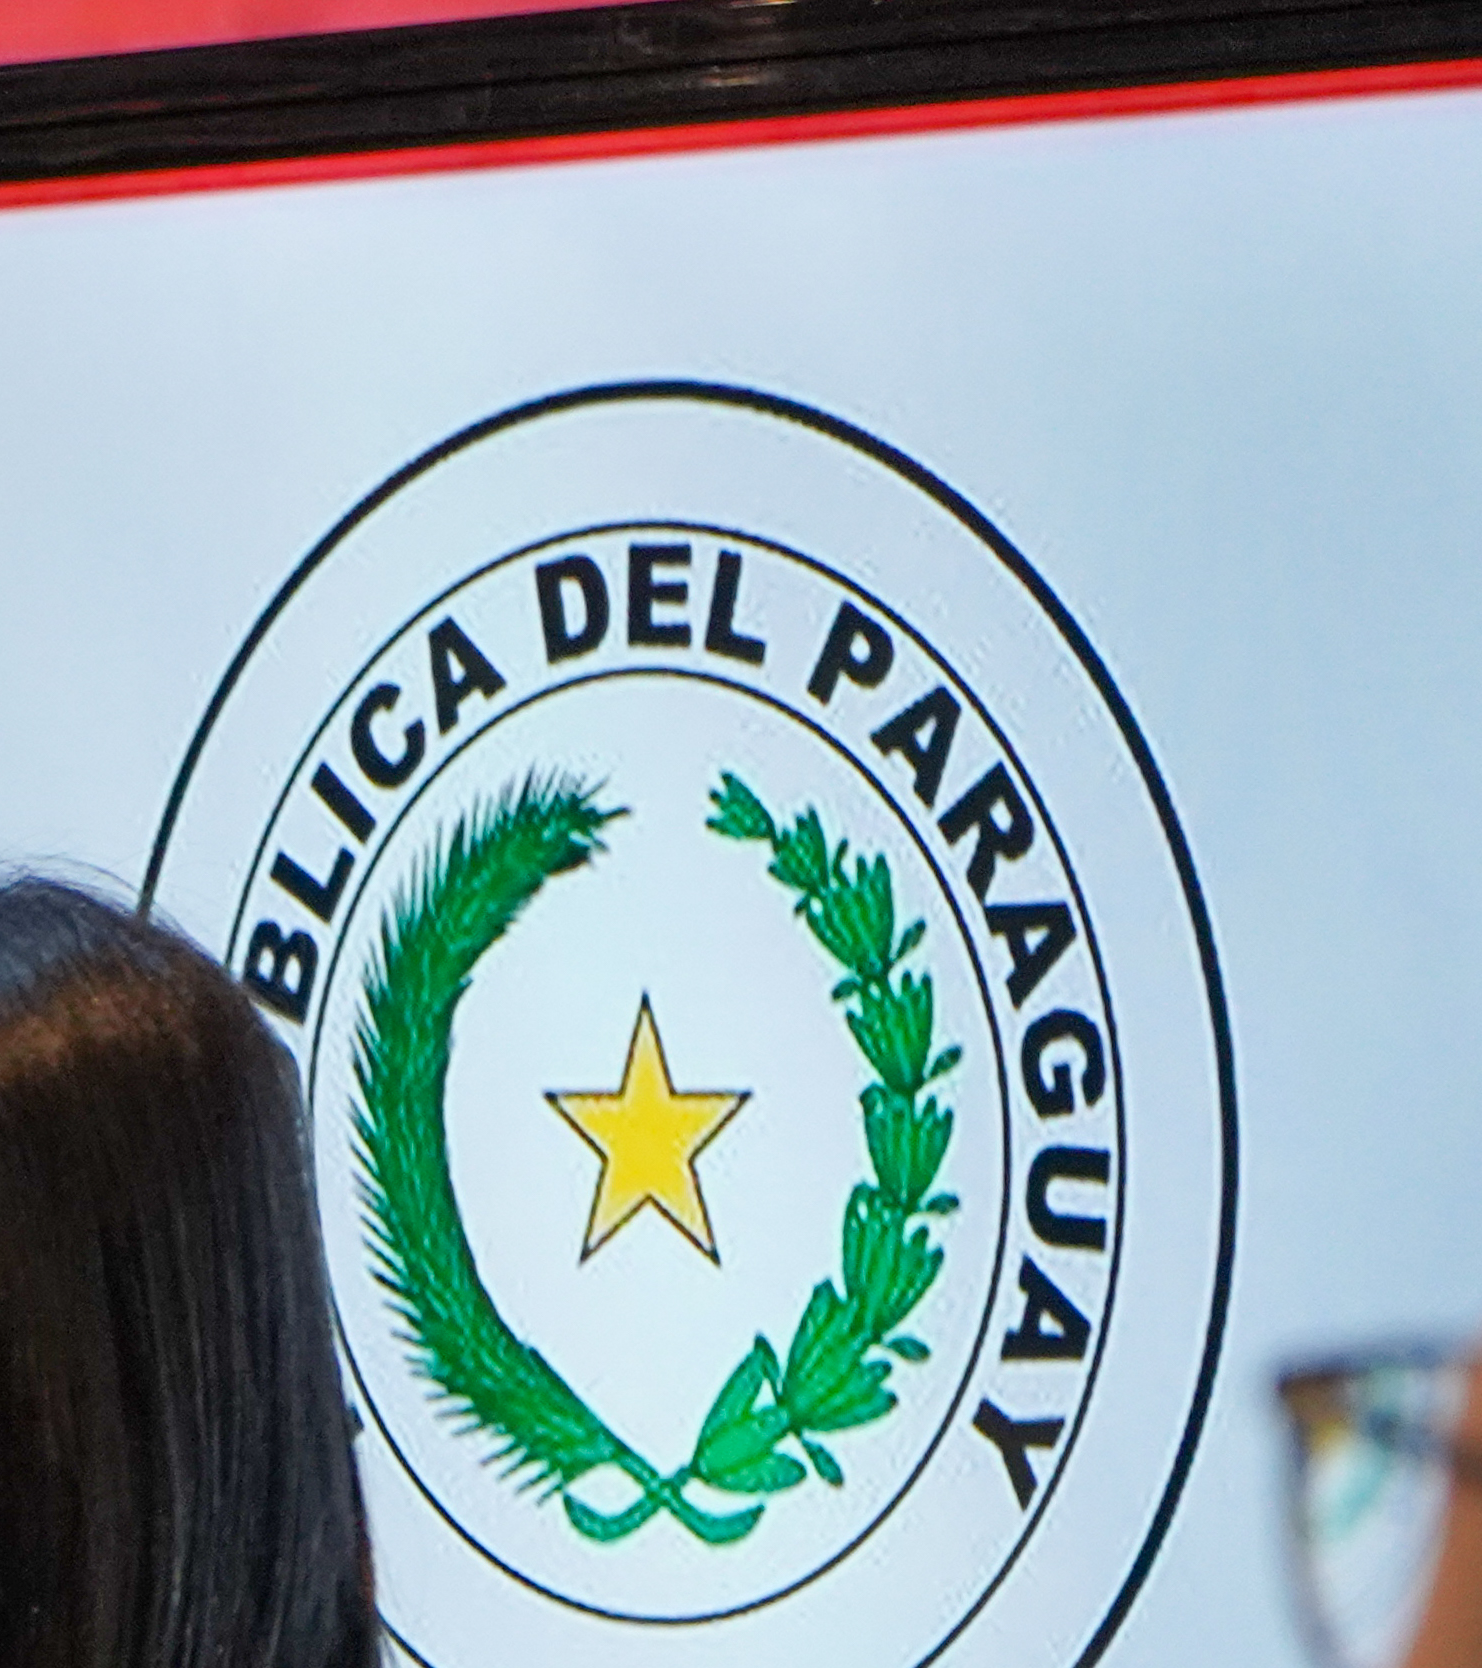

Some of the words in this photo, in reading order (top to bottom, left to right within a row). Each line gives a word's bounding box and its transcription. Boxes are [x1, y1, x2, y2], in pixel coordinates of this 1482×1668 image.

[243, 615, 508, 1027] BLICA
[535, 542, 766, 666] DEL
[804, 599, 1113, 1513] PARAGUAY
